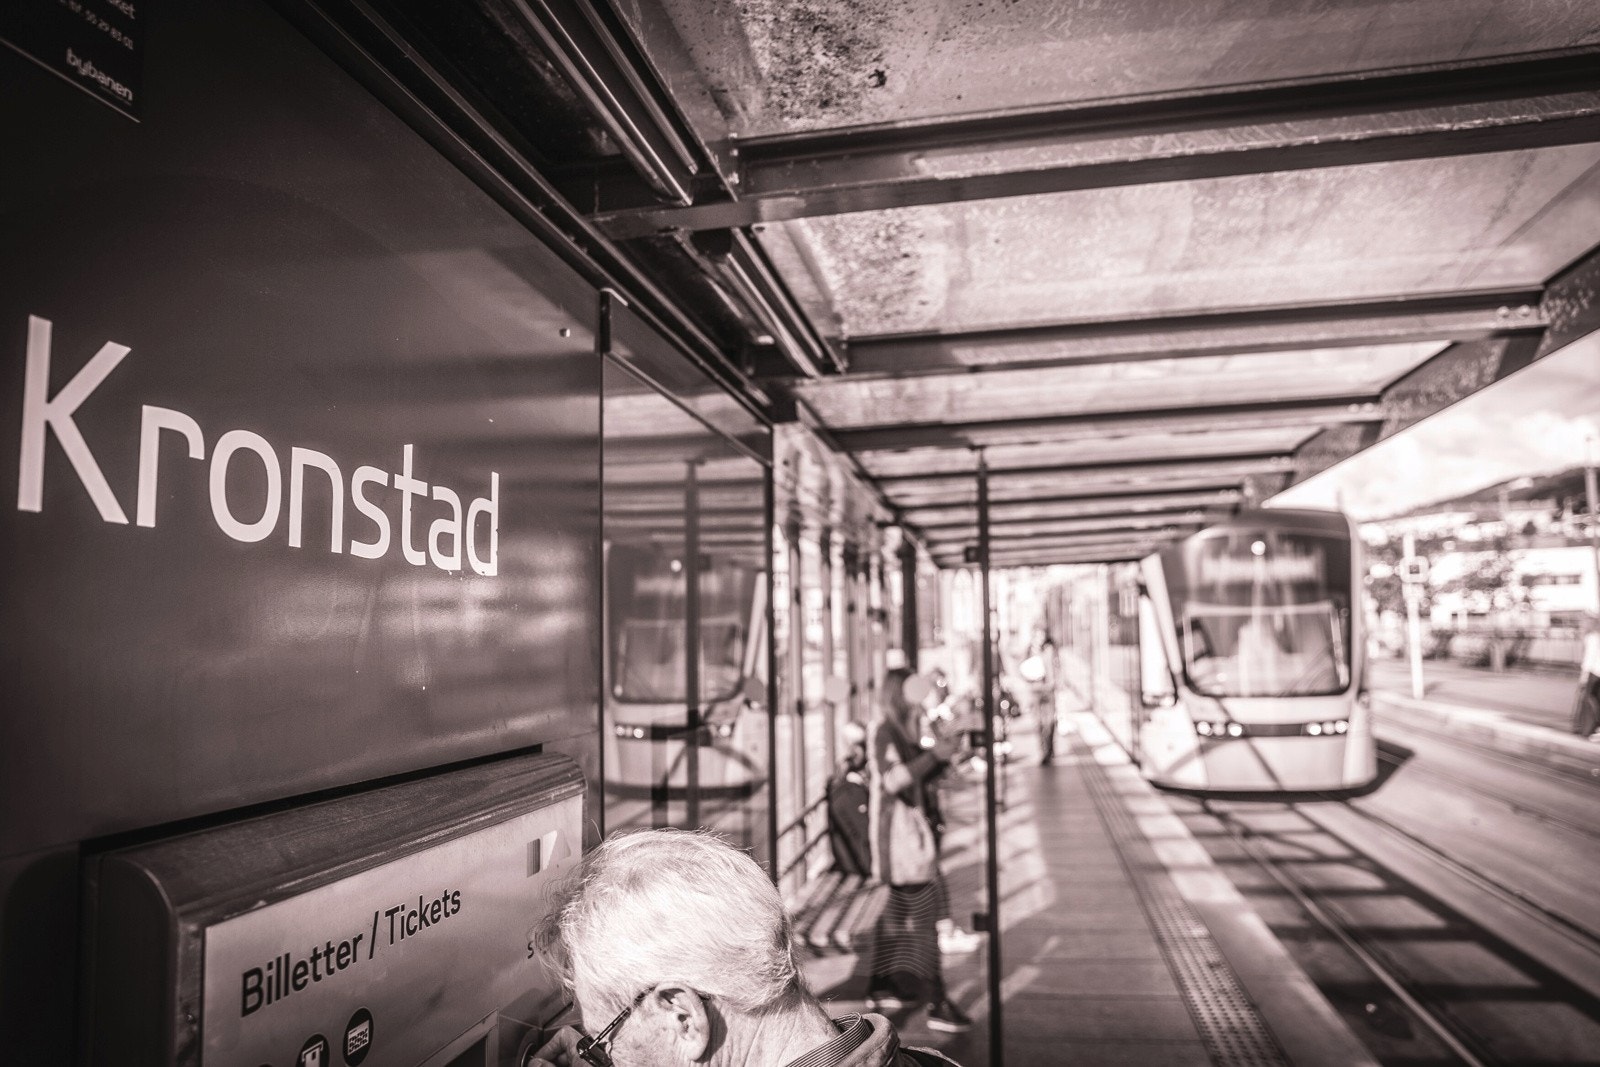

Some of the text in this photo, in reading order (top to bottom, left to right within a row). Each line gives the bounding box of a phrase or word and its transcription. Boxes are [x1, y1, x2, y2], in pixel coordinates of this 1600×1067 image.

[66, 48, 133, 101] bybanen
[17, 314, 500, 577] Kronstad
[240, 889, 461, 1018] Billetter / Tickets
